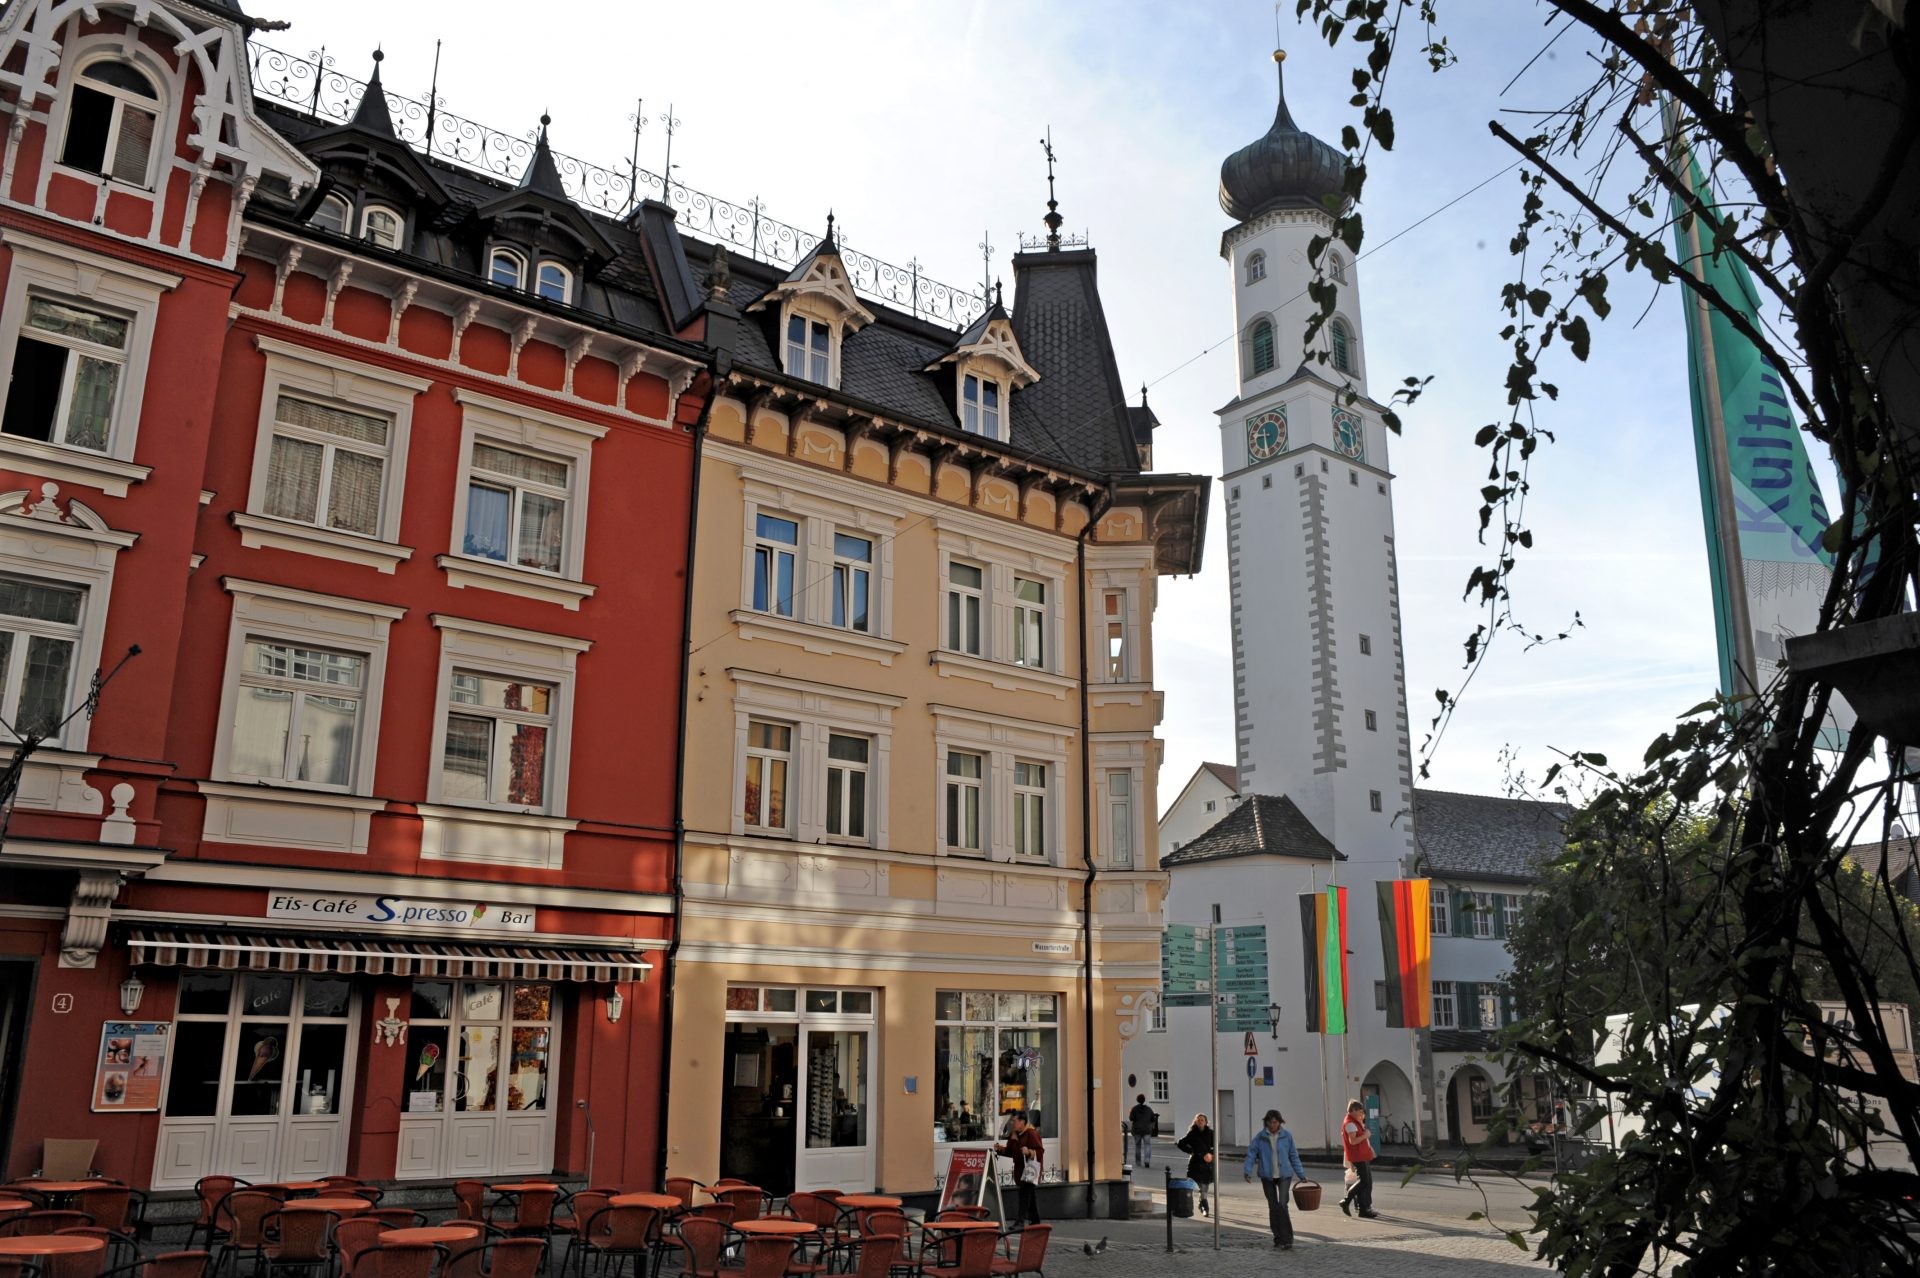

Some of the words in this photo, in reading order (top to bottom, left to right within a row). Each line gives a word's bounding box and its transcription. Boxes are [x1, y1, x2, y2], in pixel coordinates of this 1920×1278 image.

[272, 896, 358, 914] Eis-Café
[500, 910, 532, 924] Bar
[57, 997, 67, 1009] 4
